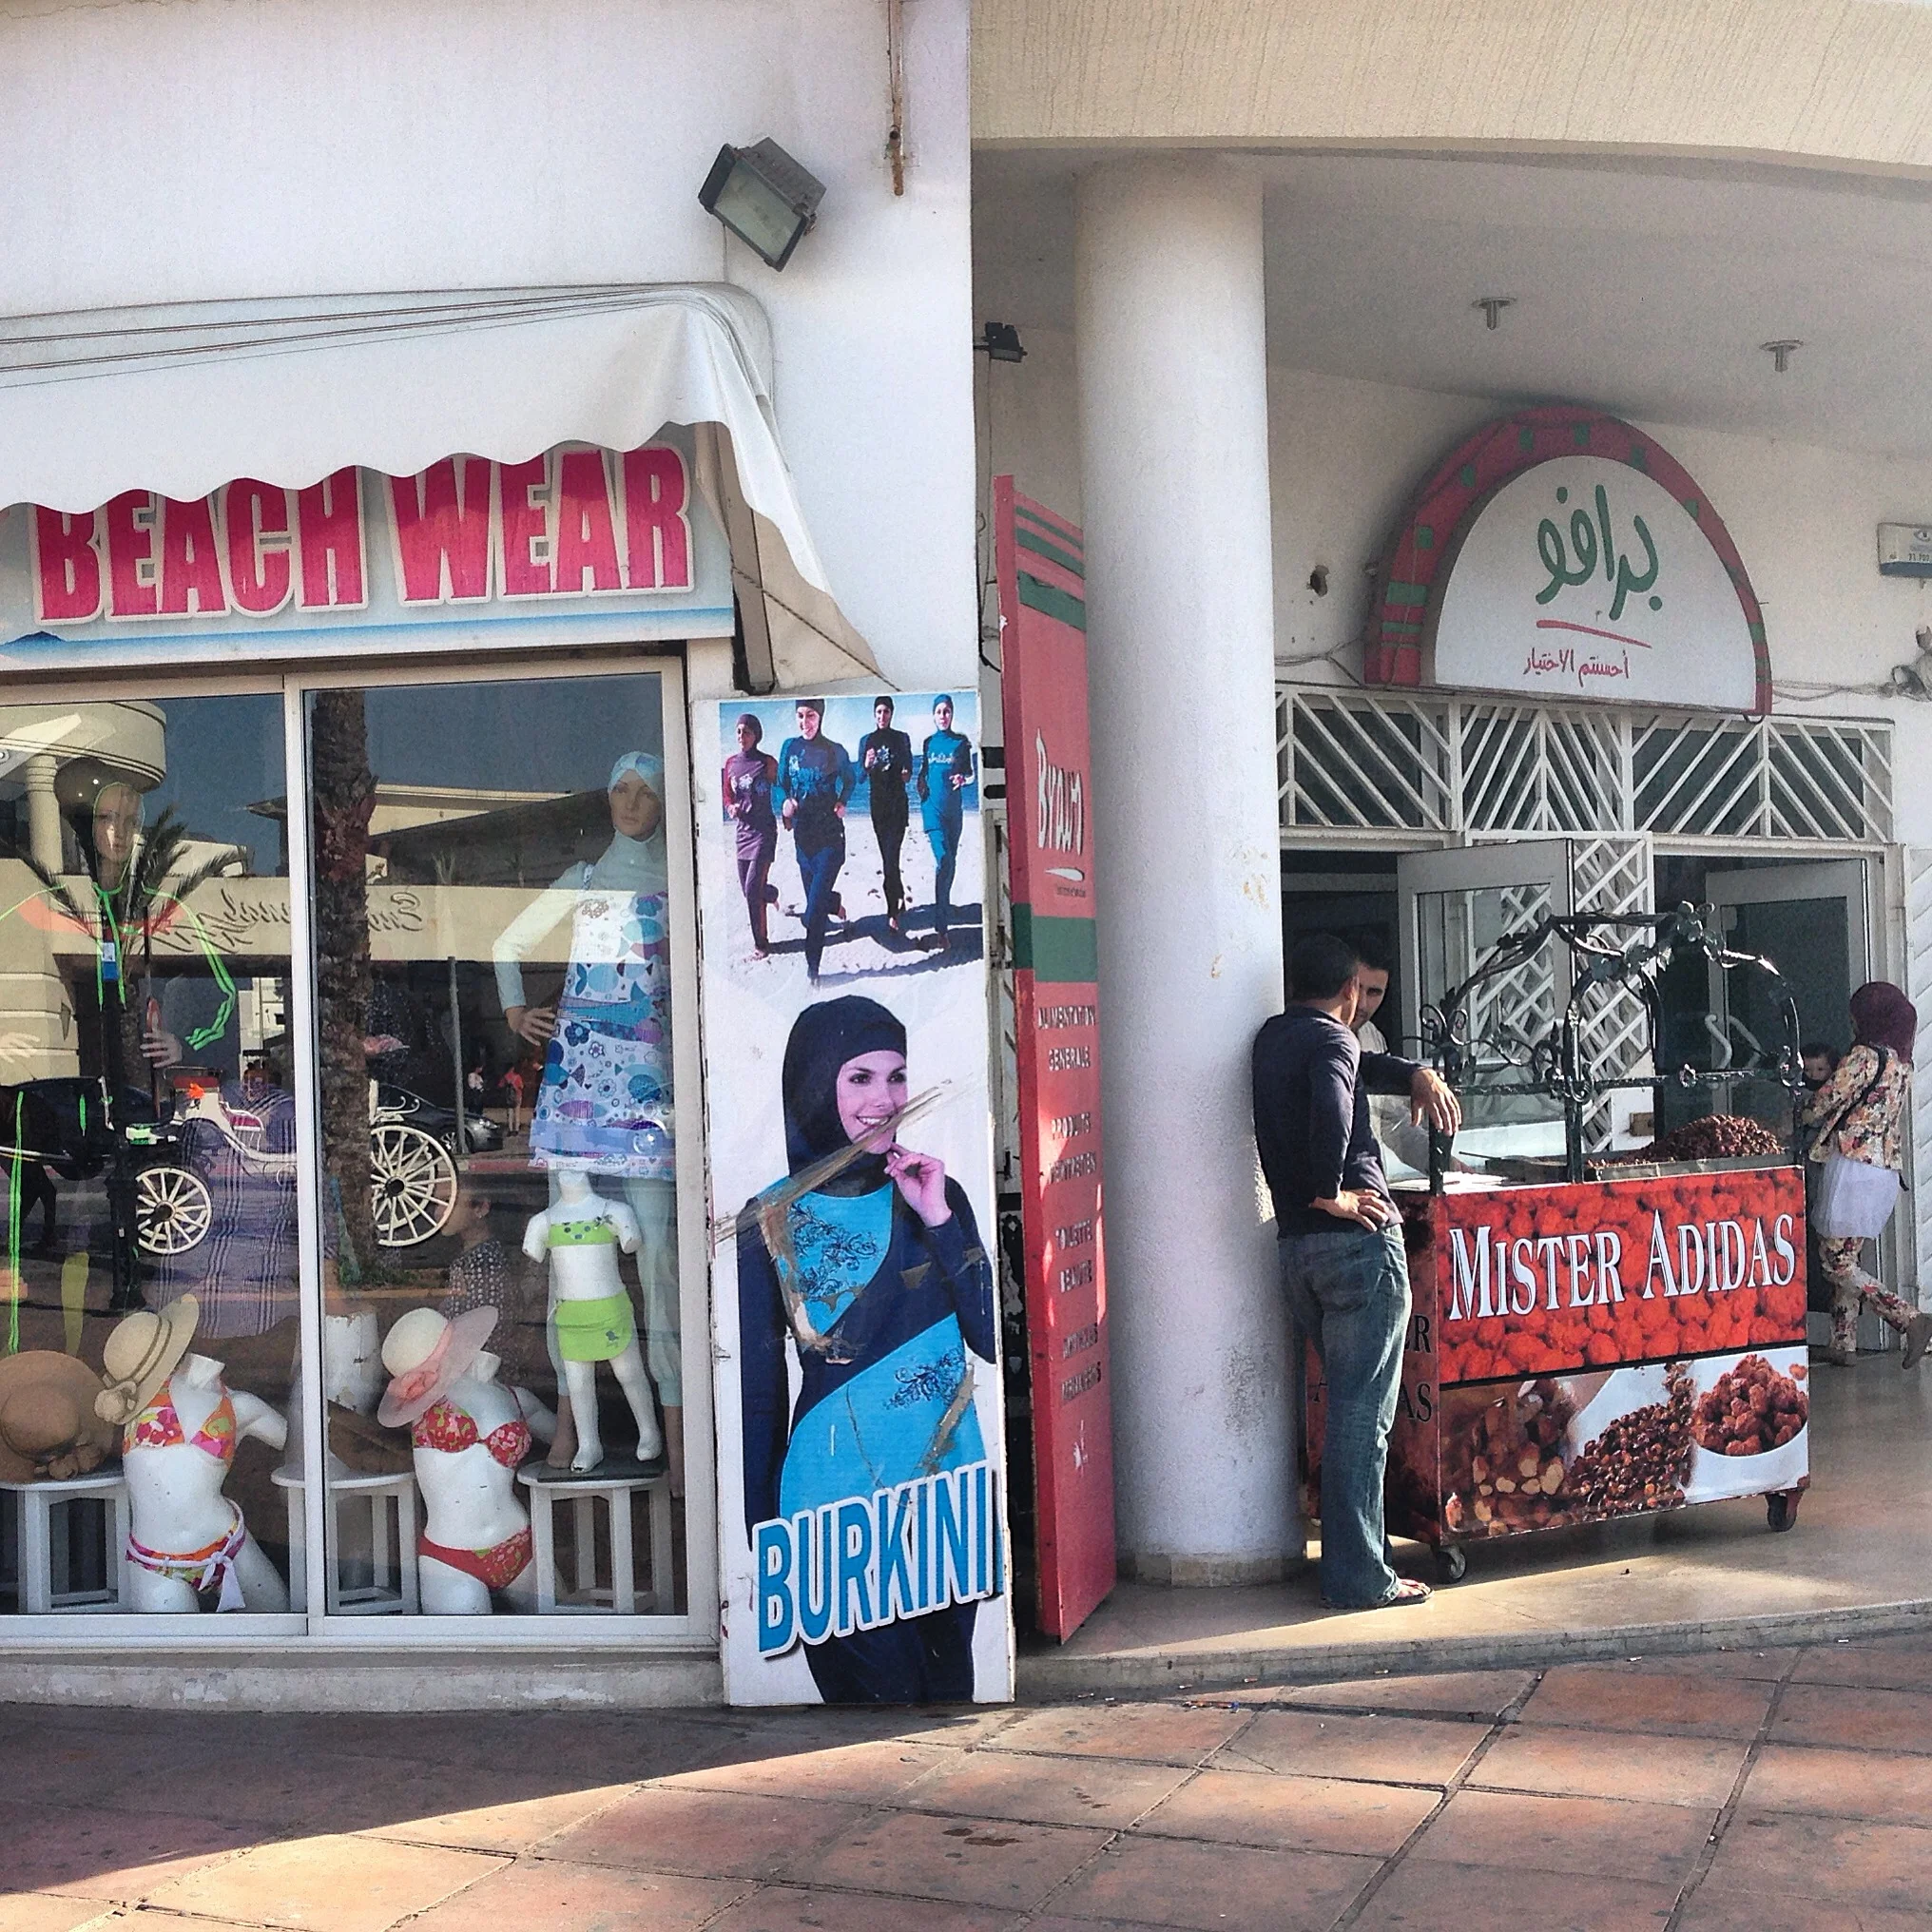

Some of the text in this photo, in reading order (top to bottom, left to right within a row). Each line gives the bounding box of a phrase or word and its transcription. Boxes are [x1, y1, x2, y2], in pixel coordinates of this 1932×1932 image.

[34, 447, 694, 625] BEACH WEAR
[1536, 484, 1663, 621] برافو
[1449, 1208, 1796, 1321] MISTER ADIDAS
[754, 1461, 991, 1654] BURKINI
